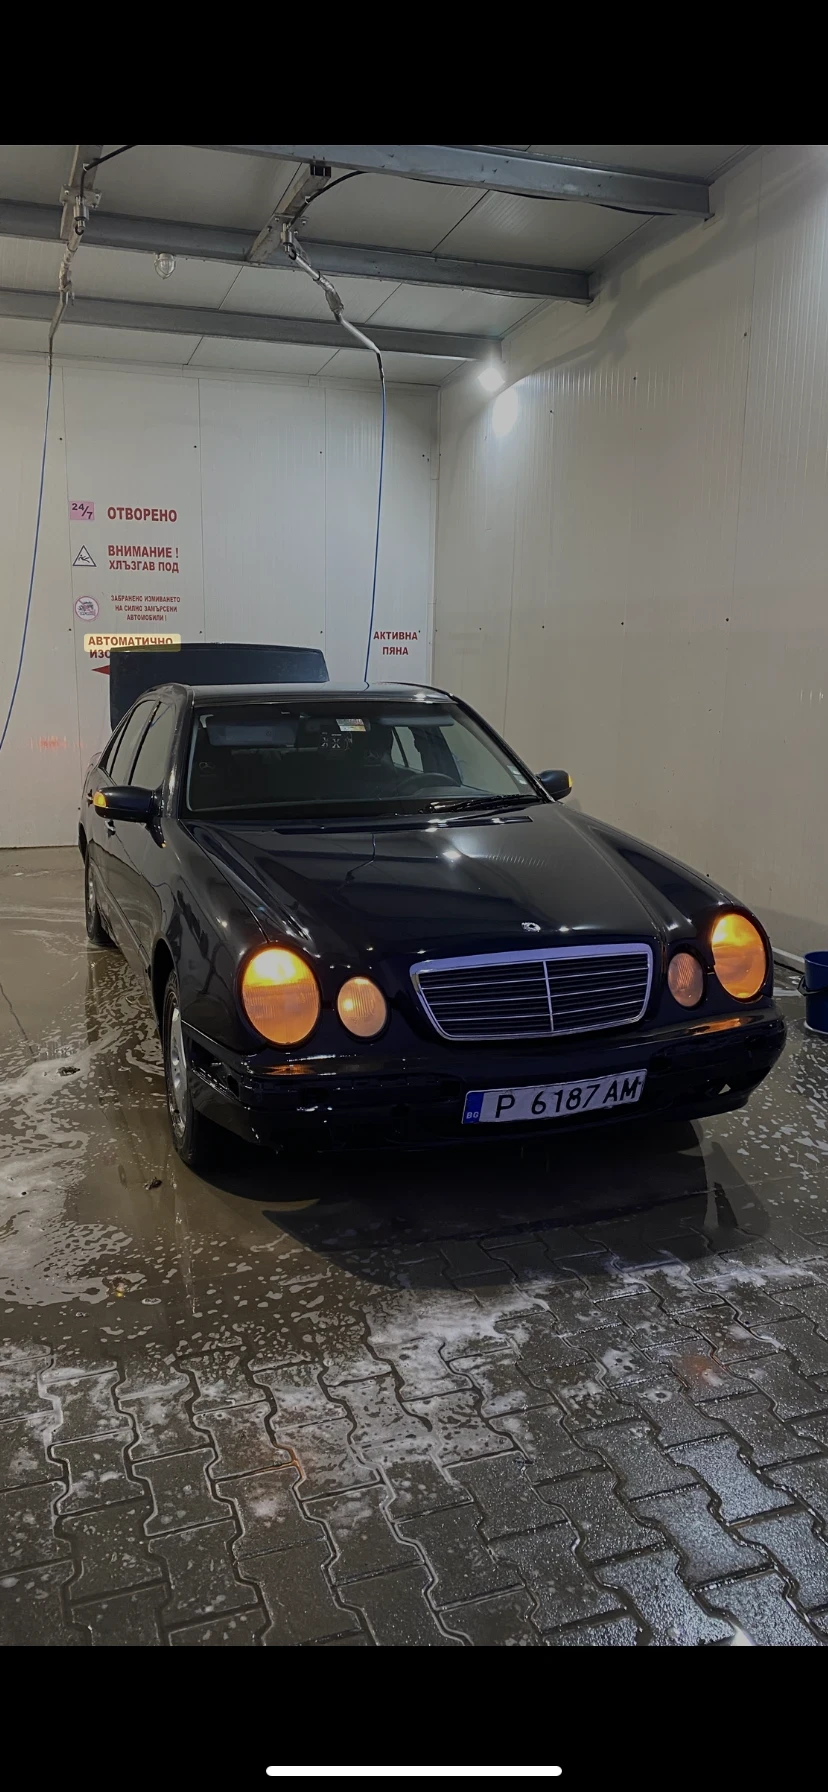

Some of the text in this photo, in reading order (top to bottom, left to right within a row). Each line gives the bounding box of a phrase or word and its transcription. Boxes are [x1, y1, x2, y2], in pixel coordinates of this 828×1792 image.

[72, 503, 177, 522] 24/7 ОТВОРЕНО
[108, 545, 179, 558] ВНИМАНИЕ !
[109, 560, 179, 573] ХЛЪЗГАВ ПОД
[88, 636, 173, 646] АВТОМАТИЧНО
[373, 631, 418, 640] АКТИВНА
[382, 647, 409, 655] ПЯНА
[495, 1076, 641, 1118] P 6187 AM
[466, 1111, 479, 1119] BG
